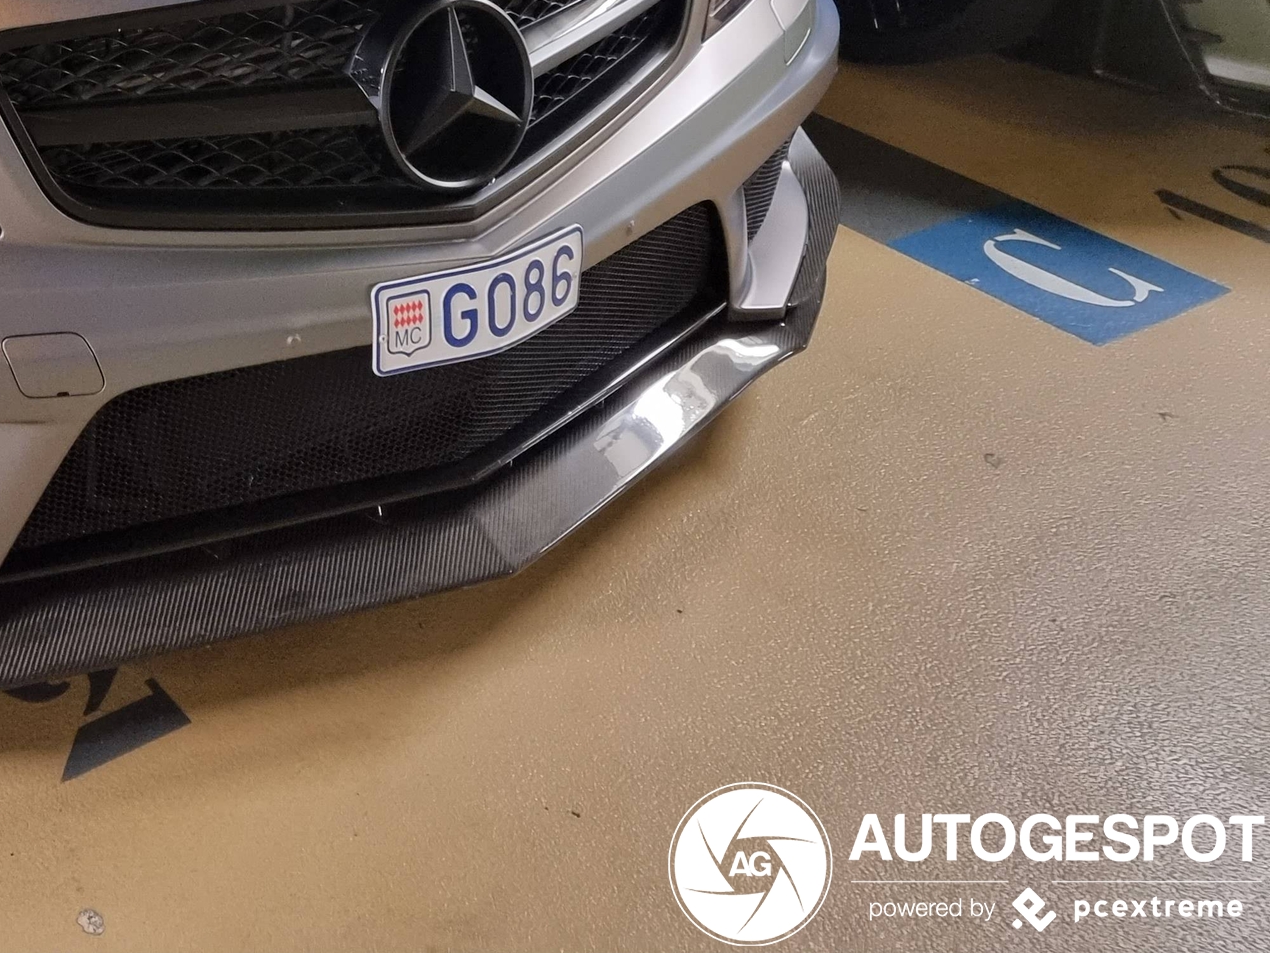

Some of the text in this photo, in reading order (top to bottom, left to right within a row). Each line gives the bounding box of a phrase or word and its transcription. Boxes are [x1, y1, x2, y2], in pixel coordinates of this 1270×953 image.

[442, 244, 575, 348] G086
[983, 228, 1165, 308] C
[394, 326, 423, 348] MC
